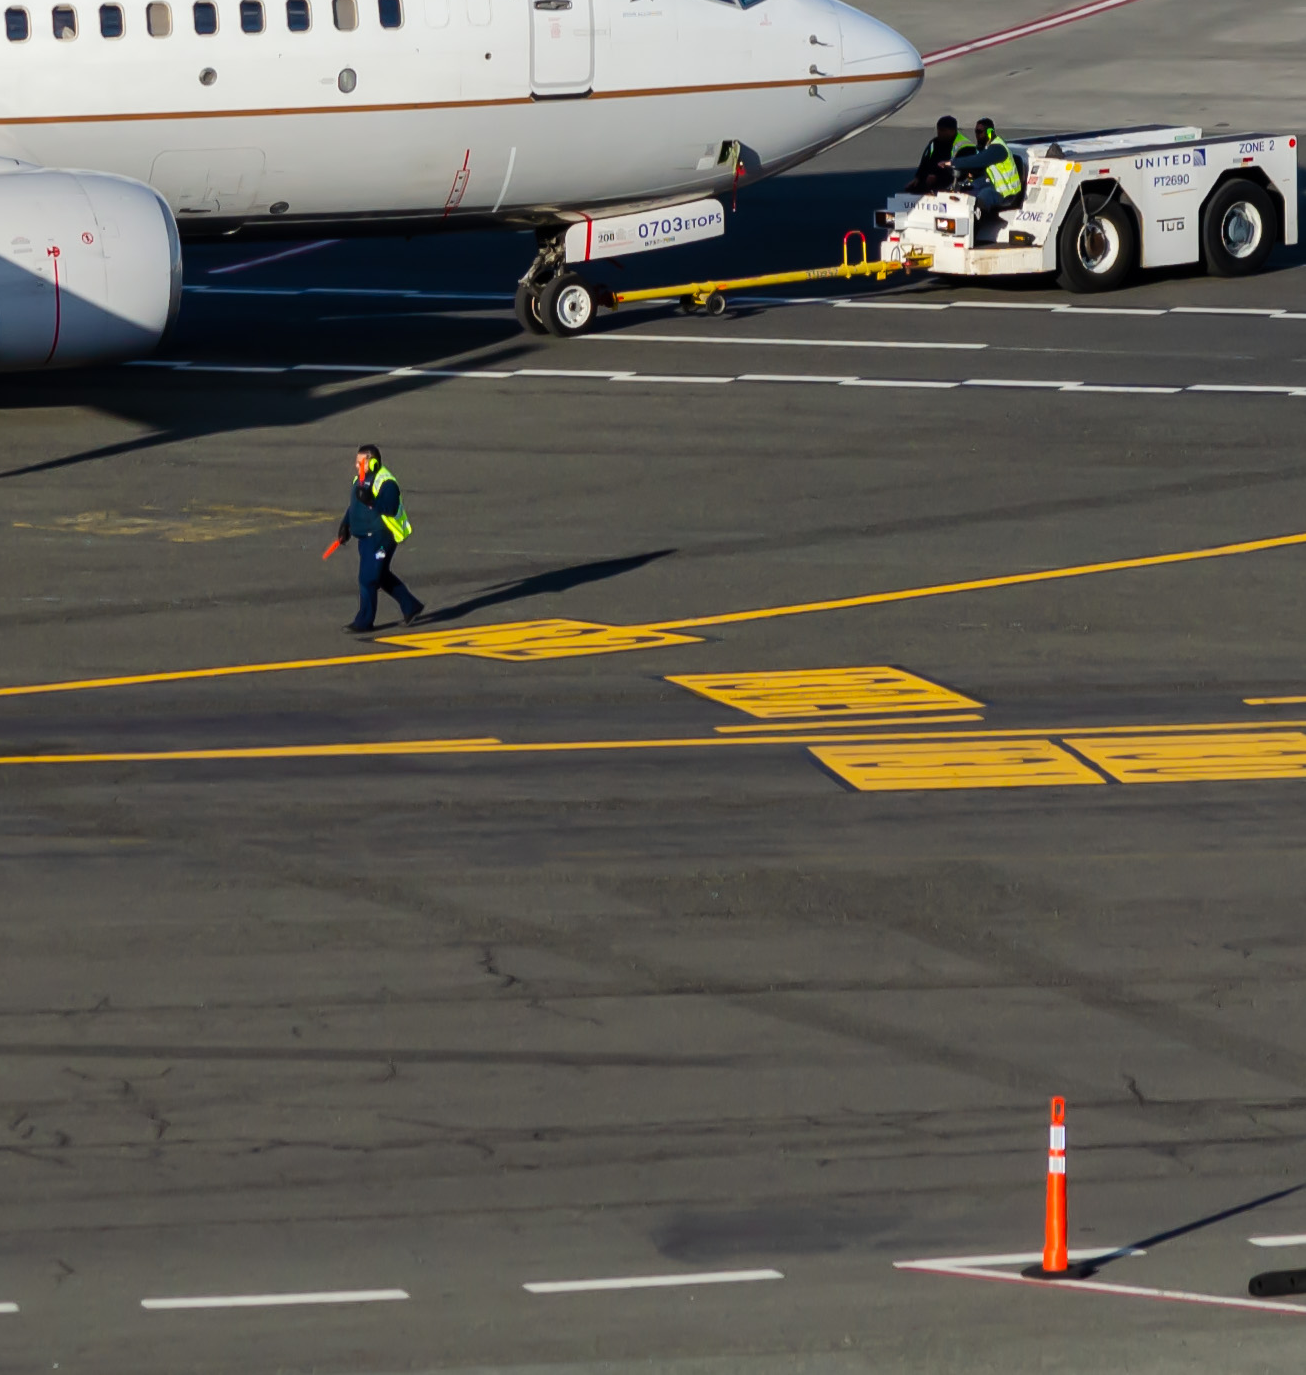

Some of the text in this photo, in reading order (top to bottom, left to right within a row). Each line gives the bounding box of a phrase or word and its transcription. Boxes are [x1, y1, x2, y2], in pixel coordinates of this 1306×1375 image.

[1239, 140, 1275, 155] ZONE 2
[1134, 153, 1191, 170] UNITED
[1154, 174, 1190, 187] PT2690
[904, 201, 939, 212] UNITED
[1015, 209, 1054, 223] ZONE 2
[638, 212, 723, 239] 0703 ETOPS
